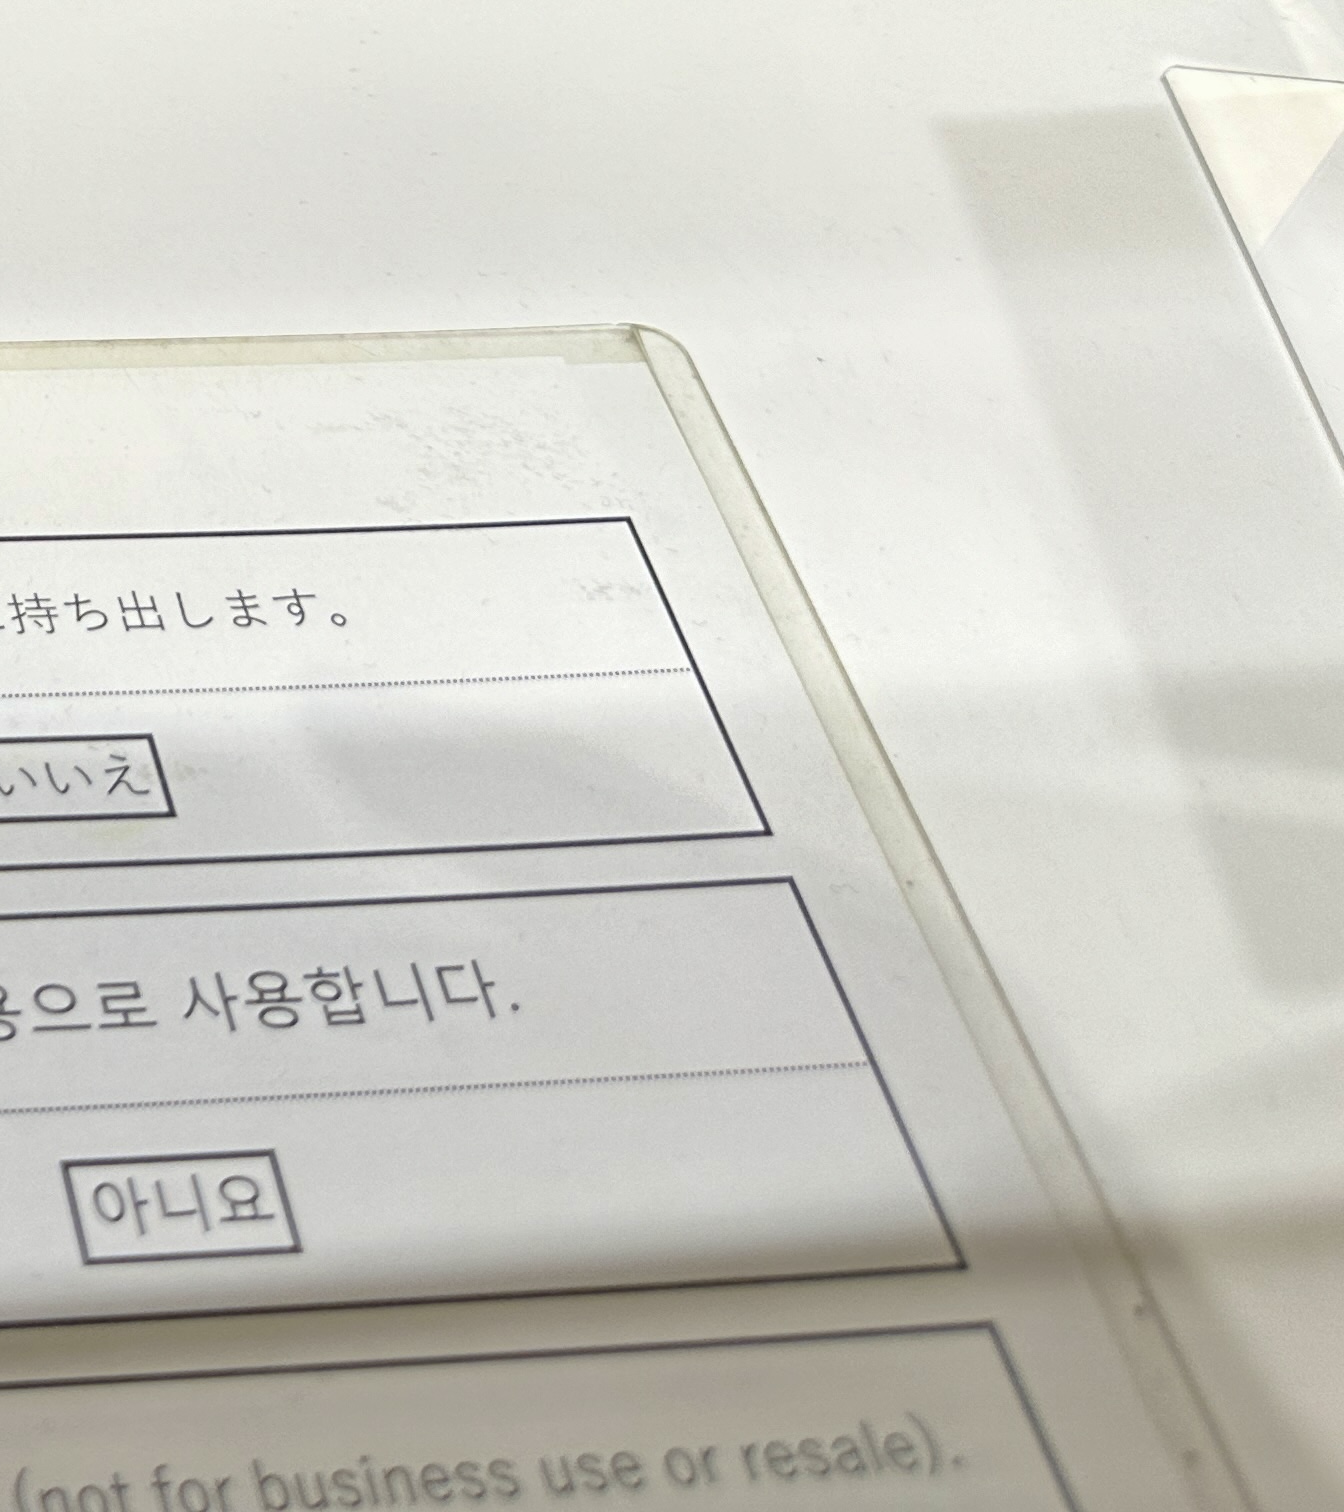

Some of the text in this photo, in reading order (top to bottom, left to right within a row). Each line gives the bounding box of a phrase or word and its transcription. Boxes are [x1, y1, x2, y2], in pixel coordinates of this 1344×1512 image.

[182, 958, 521, 1033] 사용합니다.
[91, 1173, 275, 1237] 아니요
[150, 1462, 234, 1512] for
[252, 1454, 521, 1512] business
[538, 1449, 646, 1493] use
[663, 1445, 716, 1486] or
[740, 1410, 965, 1481] resale).
